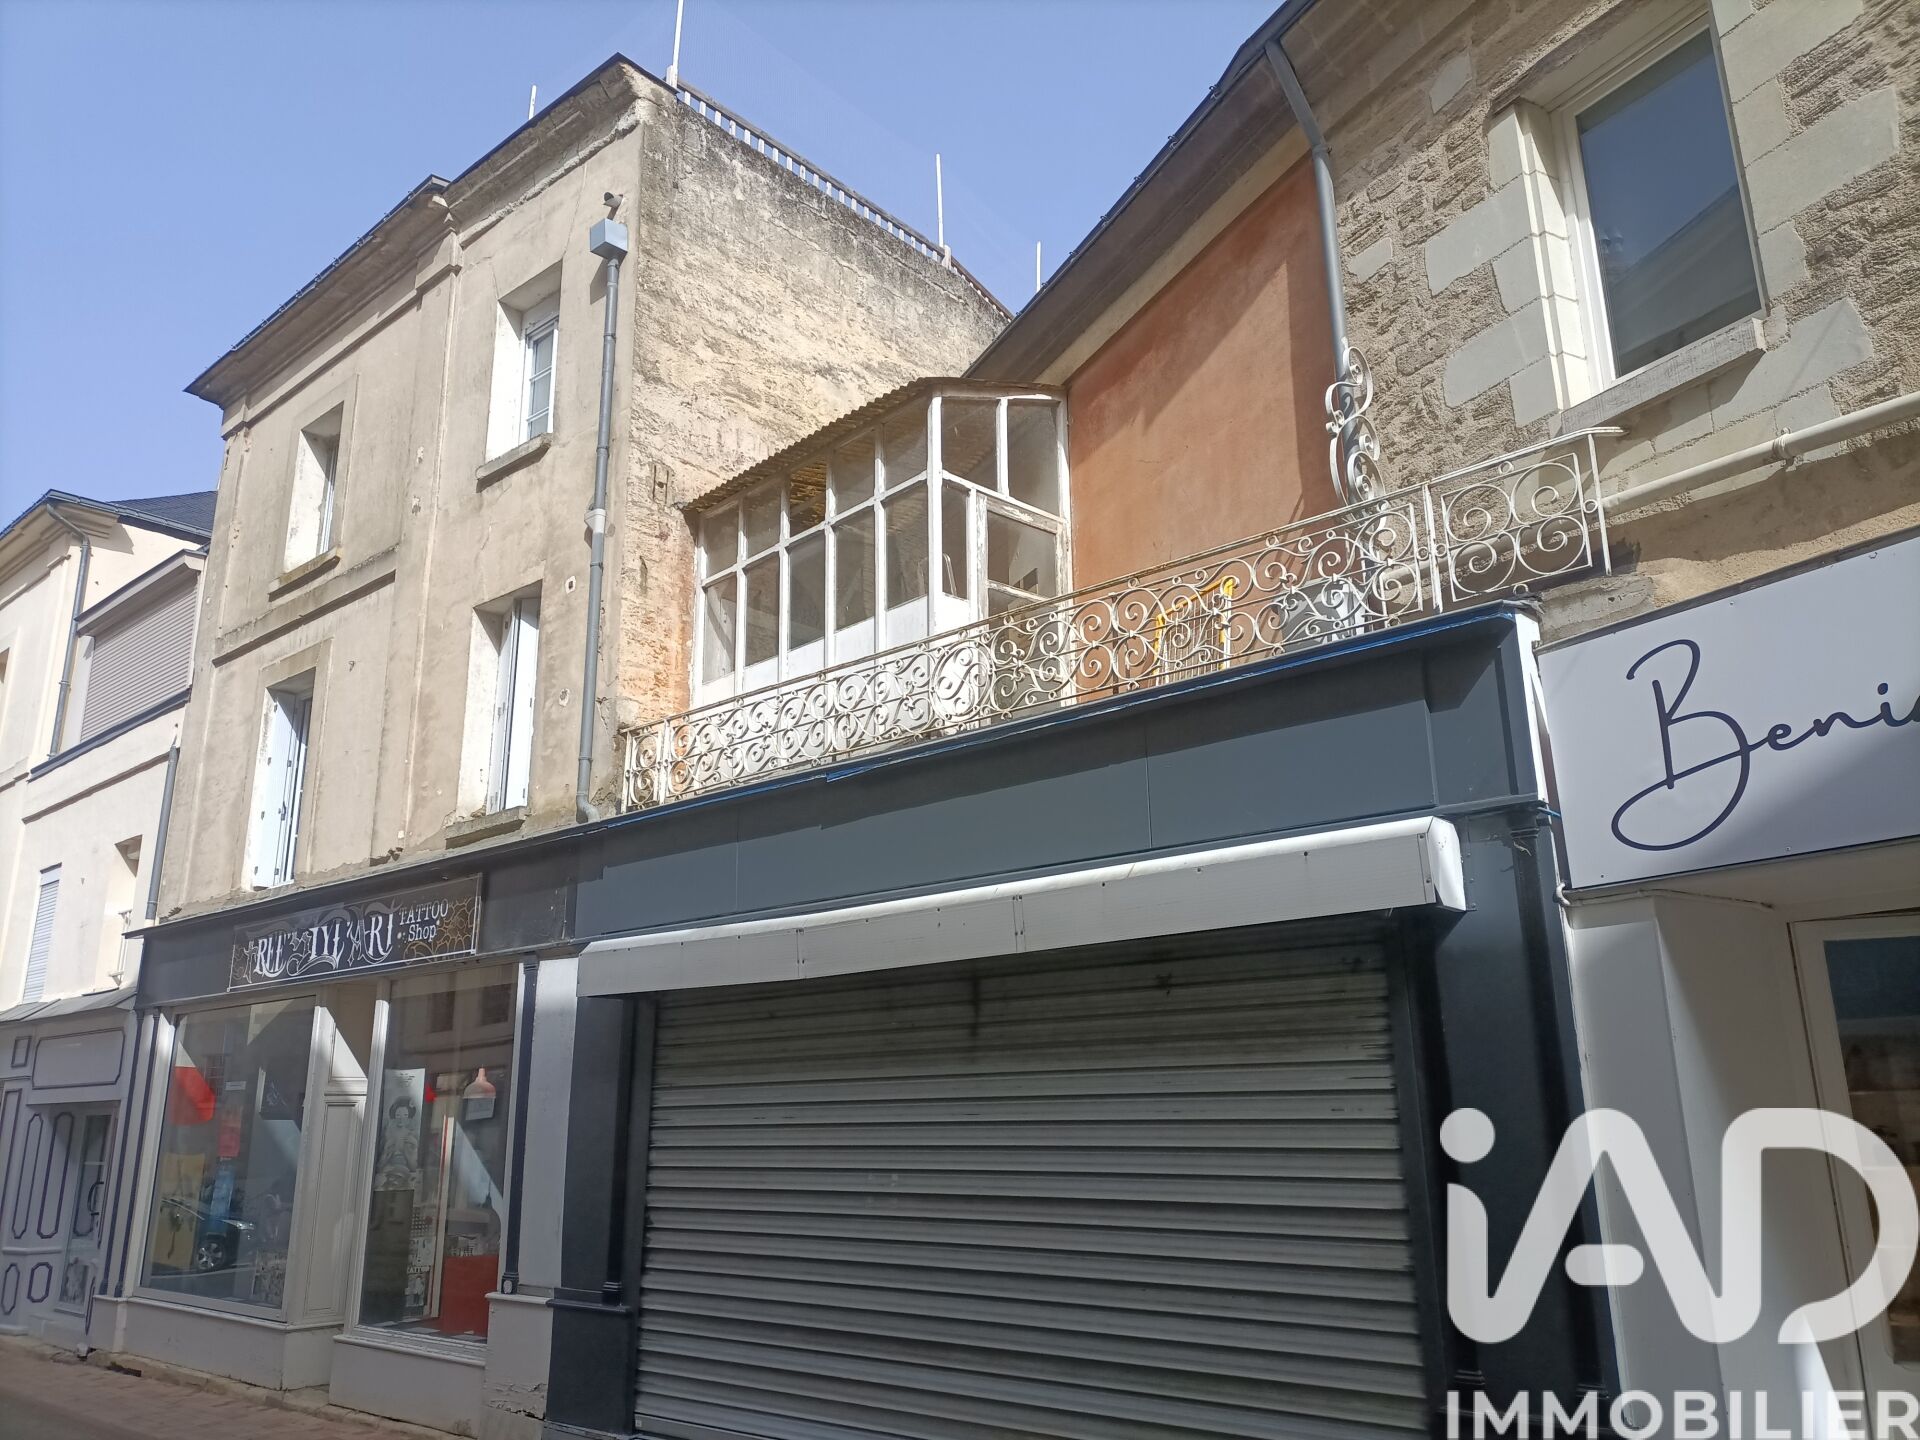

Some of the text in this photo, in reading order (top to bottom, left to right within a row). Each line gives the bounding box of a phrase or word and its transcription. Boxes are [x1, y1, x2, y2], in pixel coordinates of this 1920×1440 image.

[1611, 639, 1920, 850] Beni
[399, 898, 449, 925] TATTOO
[408, 924, 437, 942] Shop
